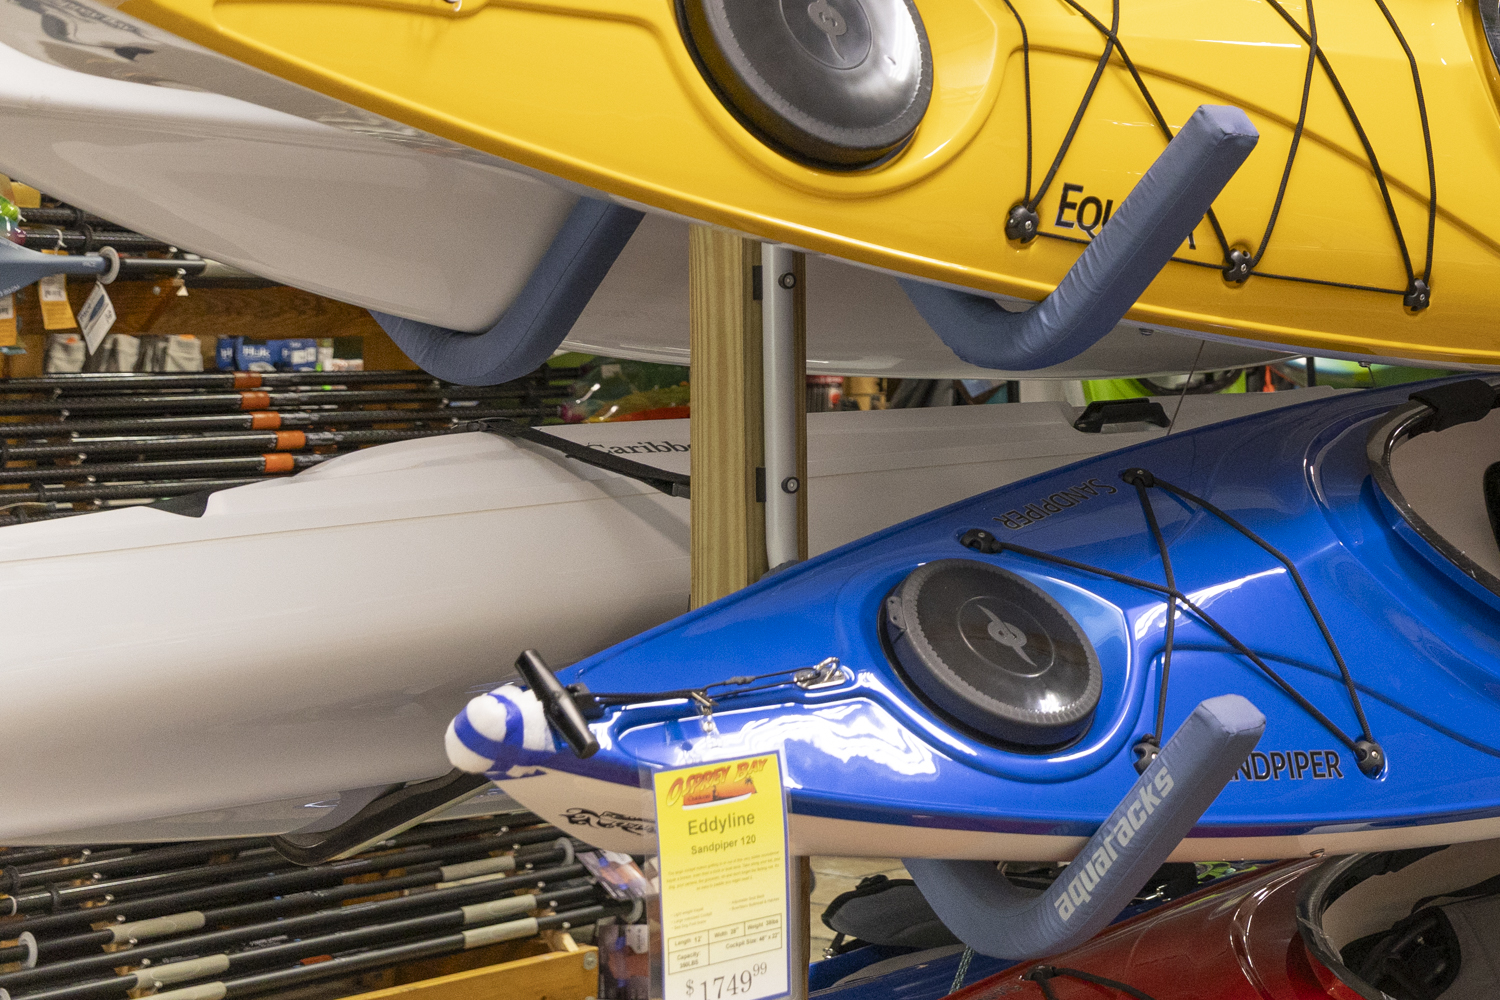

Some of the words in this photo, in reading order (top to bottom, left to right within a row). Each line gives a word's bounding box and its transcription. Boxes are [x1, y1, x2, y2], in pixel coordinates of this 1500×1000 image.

[586, 441, 691, 456] aribb
[993, 479, 1118, 530] SANDPIPER
[1231, 750, 1344, 781] NDPIPER
[666, 765, 731, 807] OSPREY
[734, 758, 768, 783] BAY
[688, 812, 755, 836] Eddyline
[691, 838, 738, 855] Sandpiper
[740, 834, 756, 846] 120
[1053, 766, 1175, 922] aquaracks
